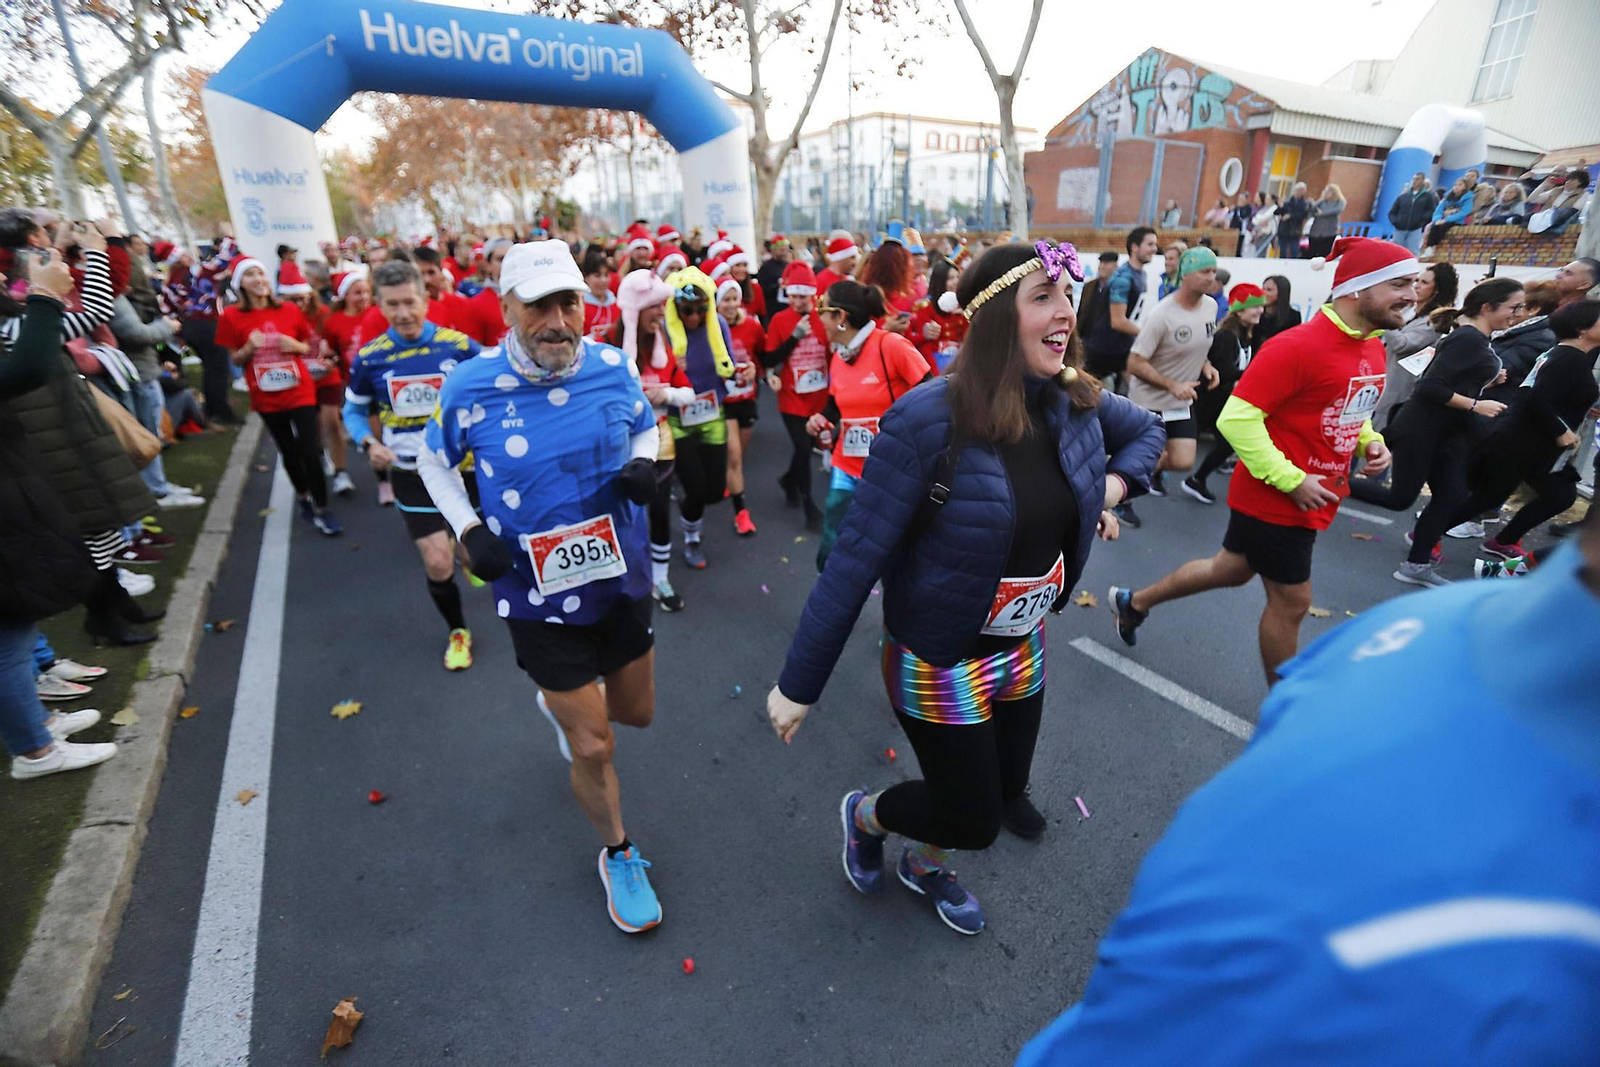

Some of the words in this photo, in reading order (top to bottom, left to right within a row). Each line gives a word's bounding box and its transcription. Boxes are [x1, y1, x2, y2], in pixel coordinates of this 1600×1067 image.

[358, 8, 512, 66] Huelva
[522, 32, 645, 82] original
[232, 166, 306, 187] Huelva
[533, 257, 554, 267] edp
[1307, 455, 1346, 471] Huelva
